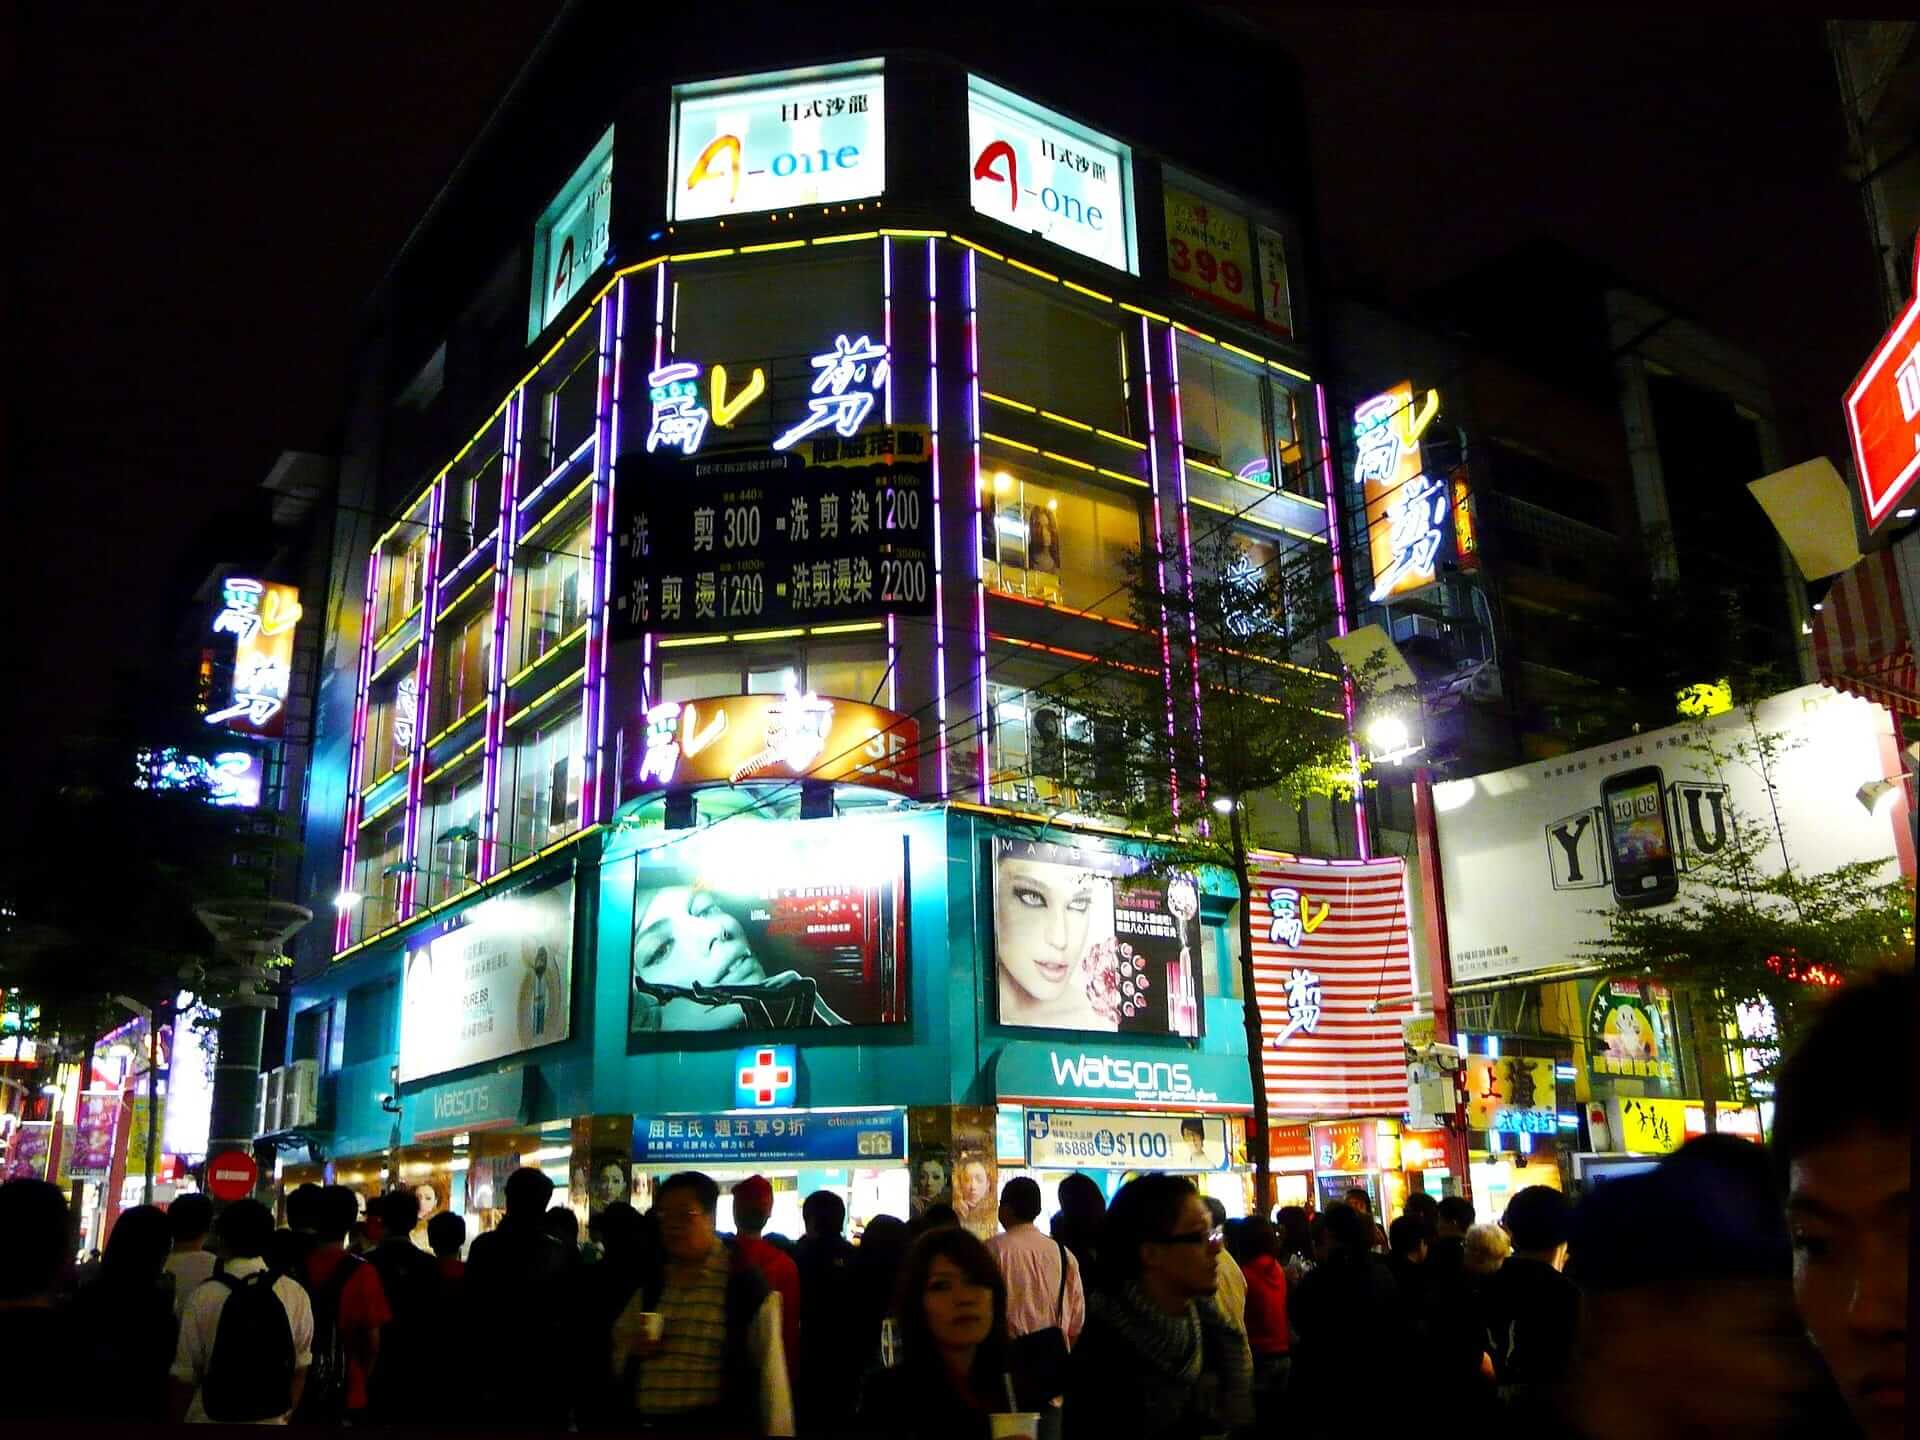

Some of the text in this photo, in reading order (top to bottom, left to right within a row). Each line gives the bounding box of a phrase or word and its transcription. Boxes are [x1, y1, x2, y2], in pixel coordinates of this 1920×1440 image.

[781, 93, 869, 124] 日式沙龍
[1041, 137, 1107, 183] 日式沙龍
[1170, 238, 1243, 295] 399
[724, 506, 761, 549] 300
[875, 488, 920, 531] 1200
[721, 572, 763, 617] 1200
[880, 560, 927, 604] 2200
[1552, 789, 1727, 882] Y U
[1050, 1051, 1193, 1091] Watsons
[433, 1084, 489, 1120] Watsons
[648, 1119, 704, 1138] 屈臣氏
[1115, 1130, 1168, 1159] $100
